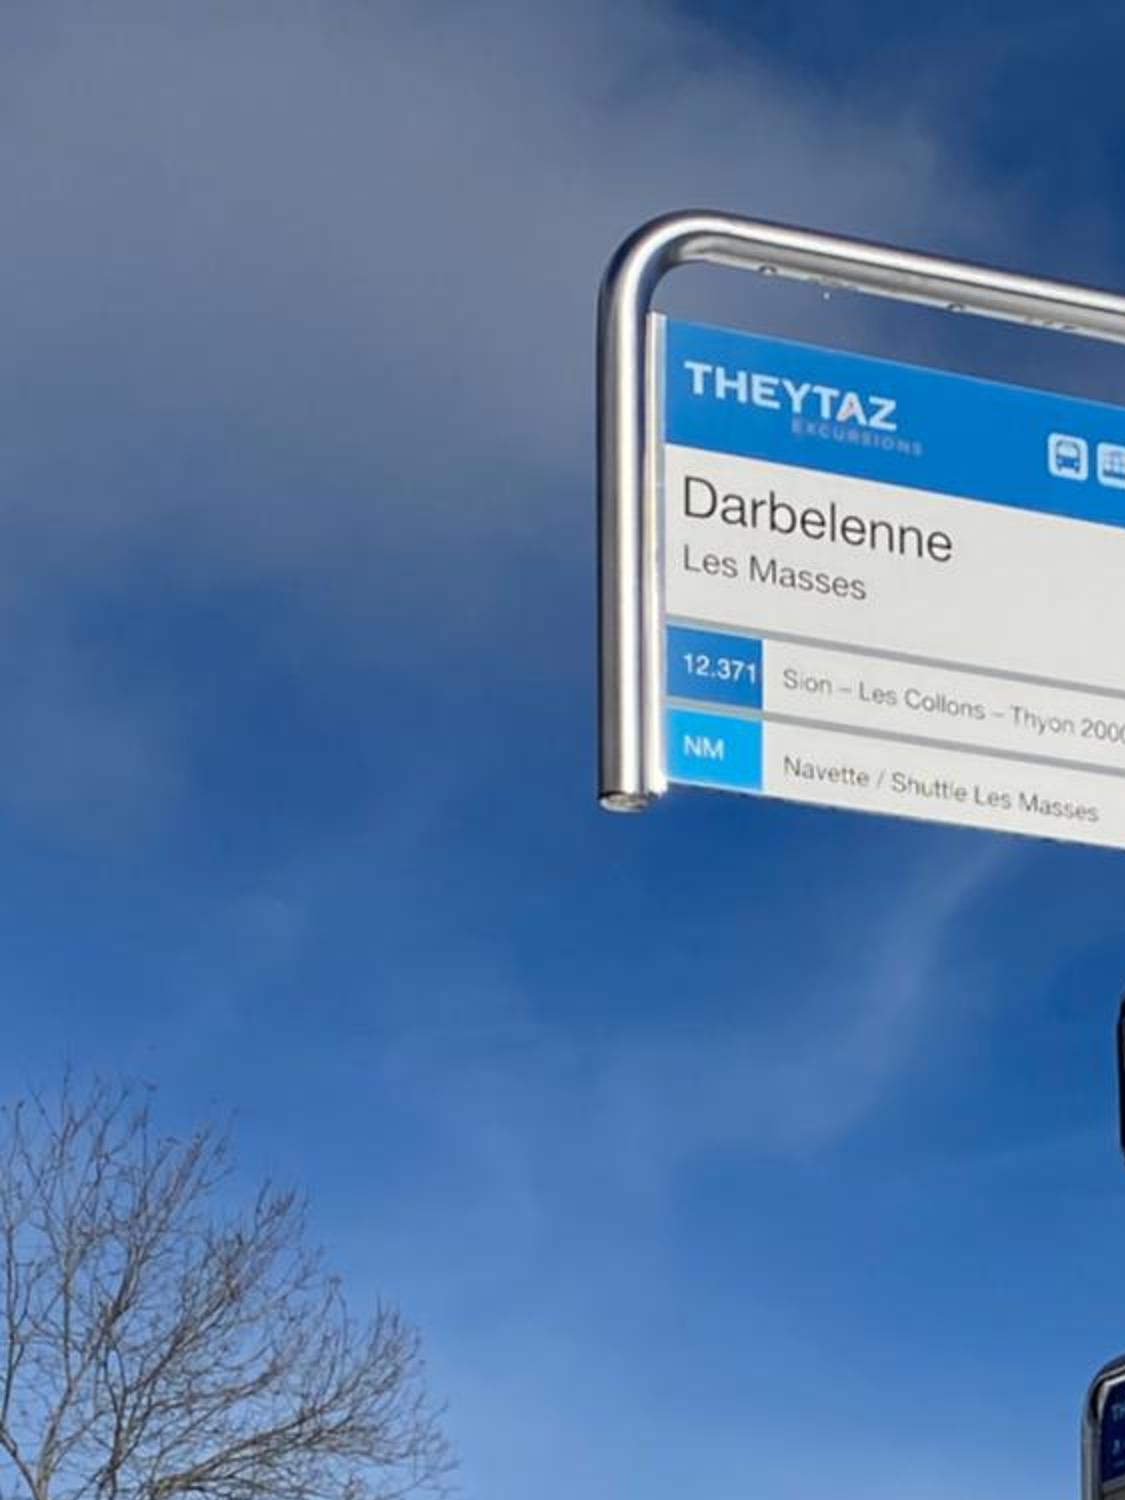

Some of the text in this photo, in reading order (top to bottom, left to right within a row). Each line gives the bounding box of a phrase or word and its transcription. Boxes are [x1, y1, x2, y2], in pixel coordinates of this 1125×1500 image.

[684, 359, 897, 432] THEYTAZ
[683, 475, 953, 562] Darbelenne
[683, 543, 867, 601] Les Masses
[683, 652, 757, 683] 12.371
[783, 668, 832, 694] Sion
[859, 681, 898, 706] Les
[904, 687, 986, 721] Collons
[1010, 704, 1075, 735] Thyon
[684, 735, 725, 760] NM
[784, 755, 869, 788] Navette
[891, 771, 968, 801] Shuttle
[974, 785, 1012, 810] Les
[1018, 791, 1100, 824] Masses
